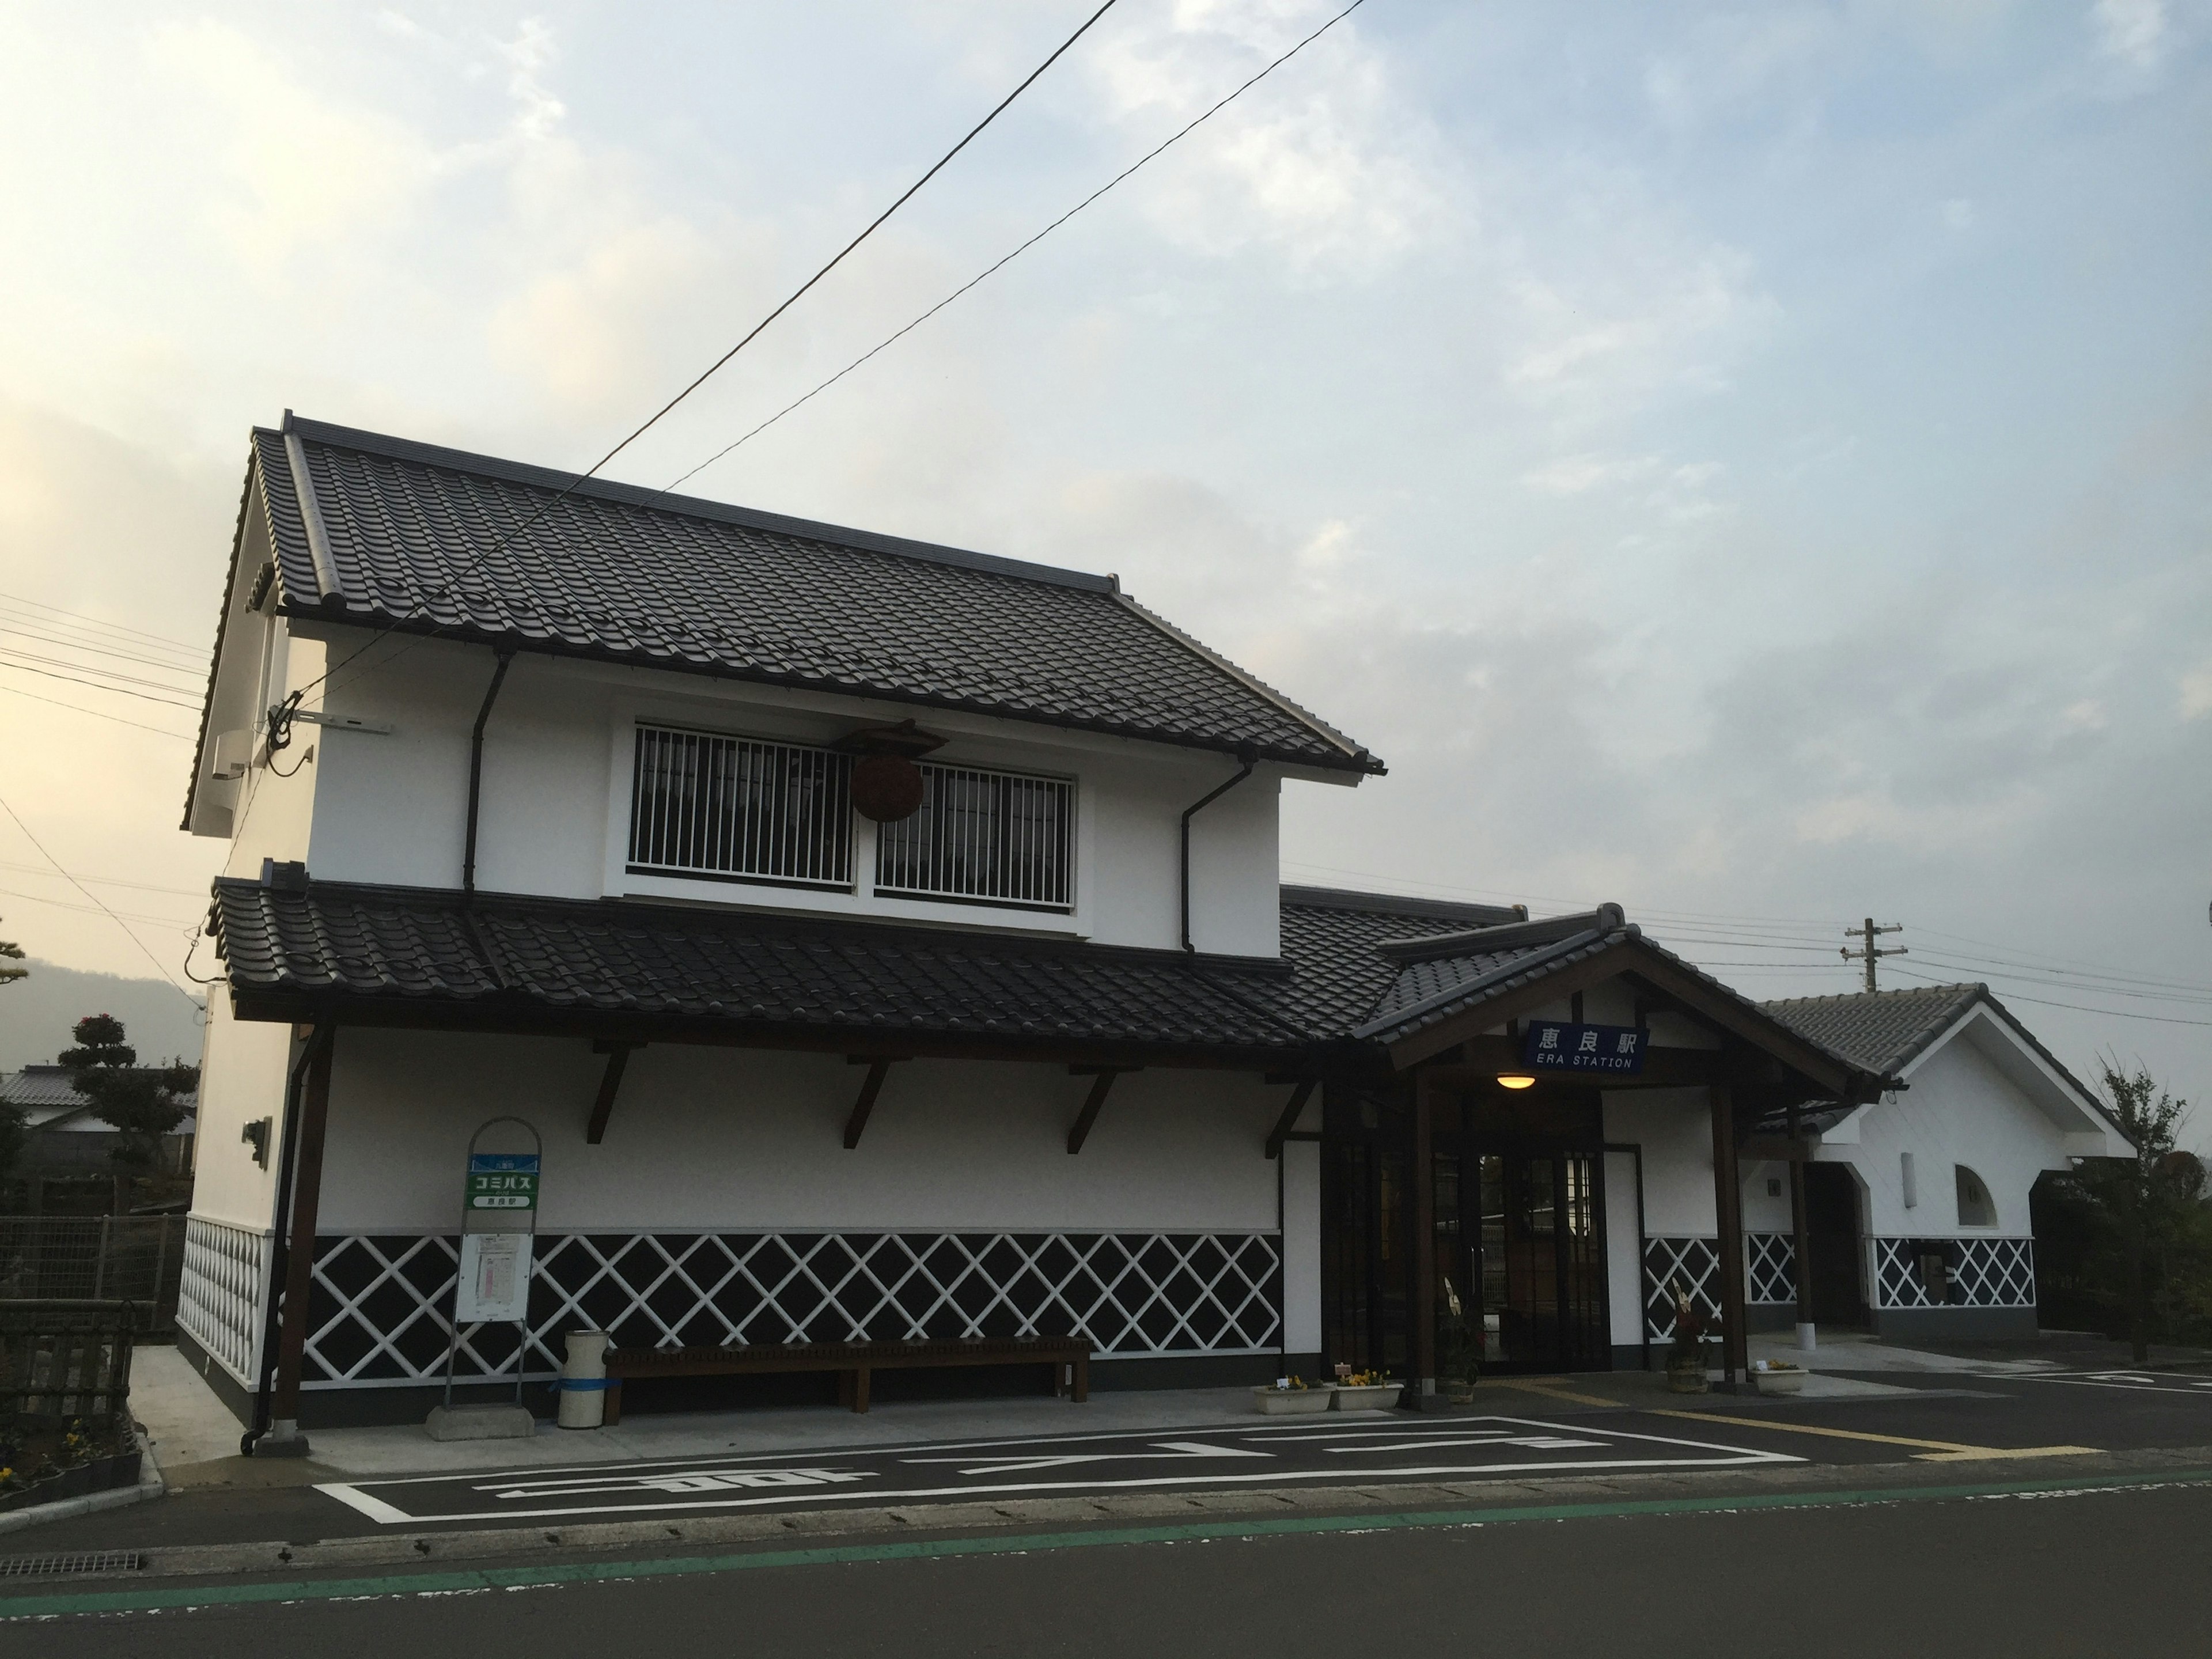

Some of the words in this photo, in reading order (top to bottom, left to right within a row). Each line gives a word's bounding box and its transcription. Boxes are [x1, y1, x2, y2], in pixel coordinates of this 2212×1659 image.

[1539, 1027, 1638, 1054] 恵良駅
[1536, 1053, 1564, 1064] ERA
[1573, 1055, 1632, 1068] STATION
[476, 1175, 532, 1190] コミバス
